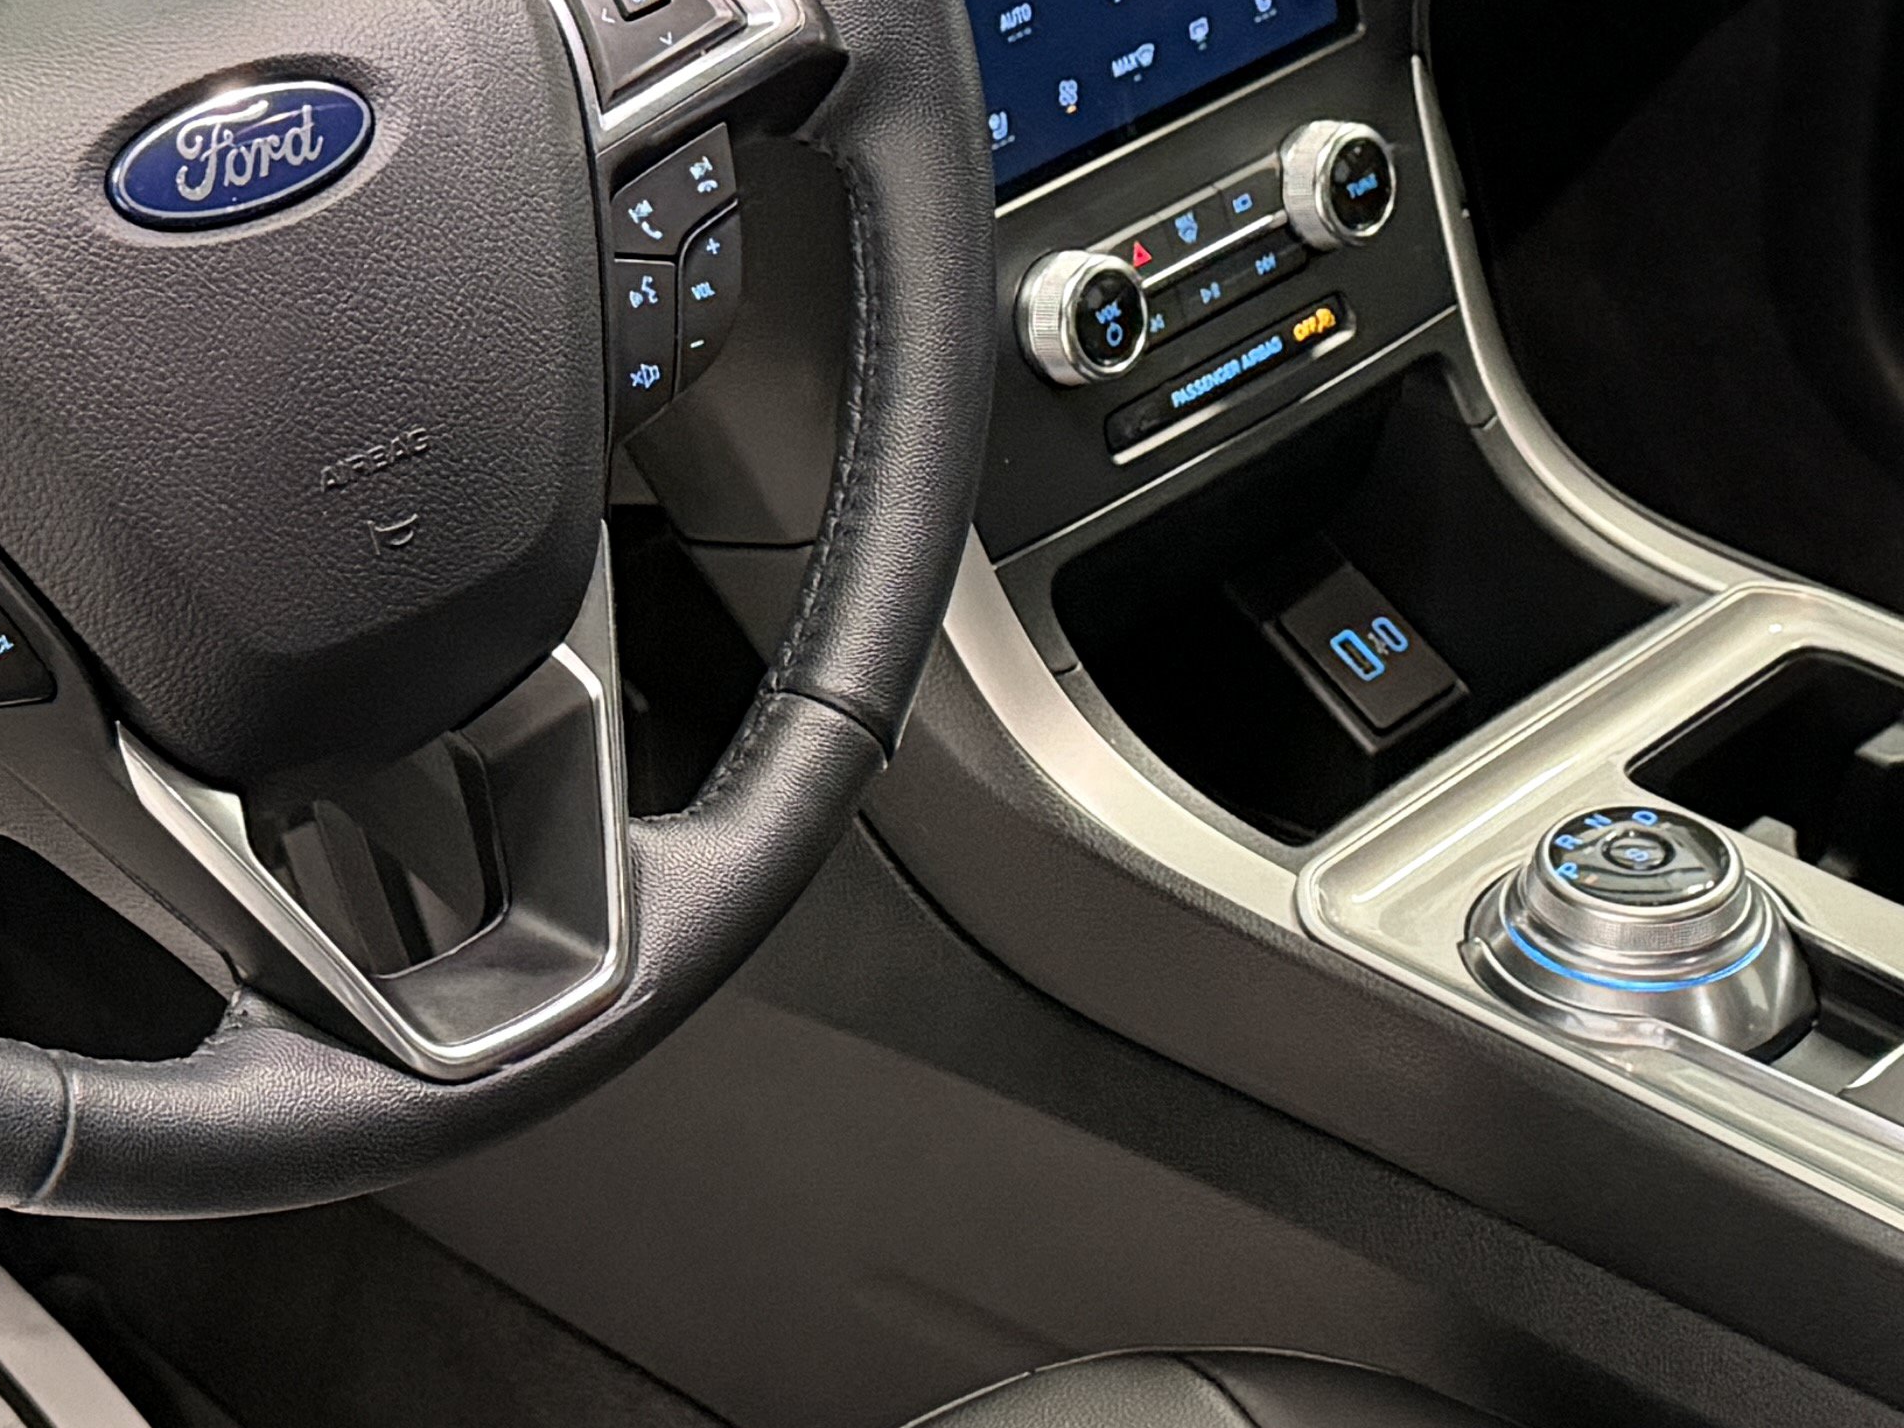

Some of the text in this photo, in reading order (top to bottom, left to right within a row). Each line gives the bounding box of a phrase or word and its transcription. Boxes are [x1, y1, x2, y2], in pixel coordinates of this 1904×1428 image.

[1000, 3, 1033, 33] AUTO
[176, 98, 325, 203] Ford
[1171, 315, 1317, 409] PASSENGER AIRBAG OFF
[1584, 813, 1612, 829] N
[1631, 810, 1658, 827] D
[1554, 834, 1583, 850] R
[1555, 861, 1579, 880] P
